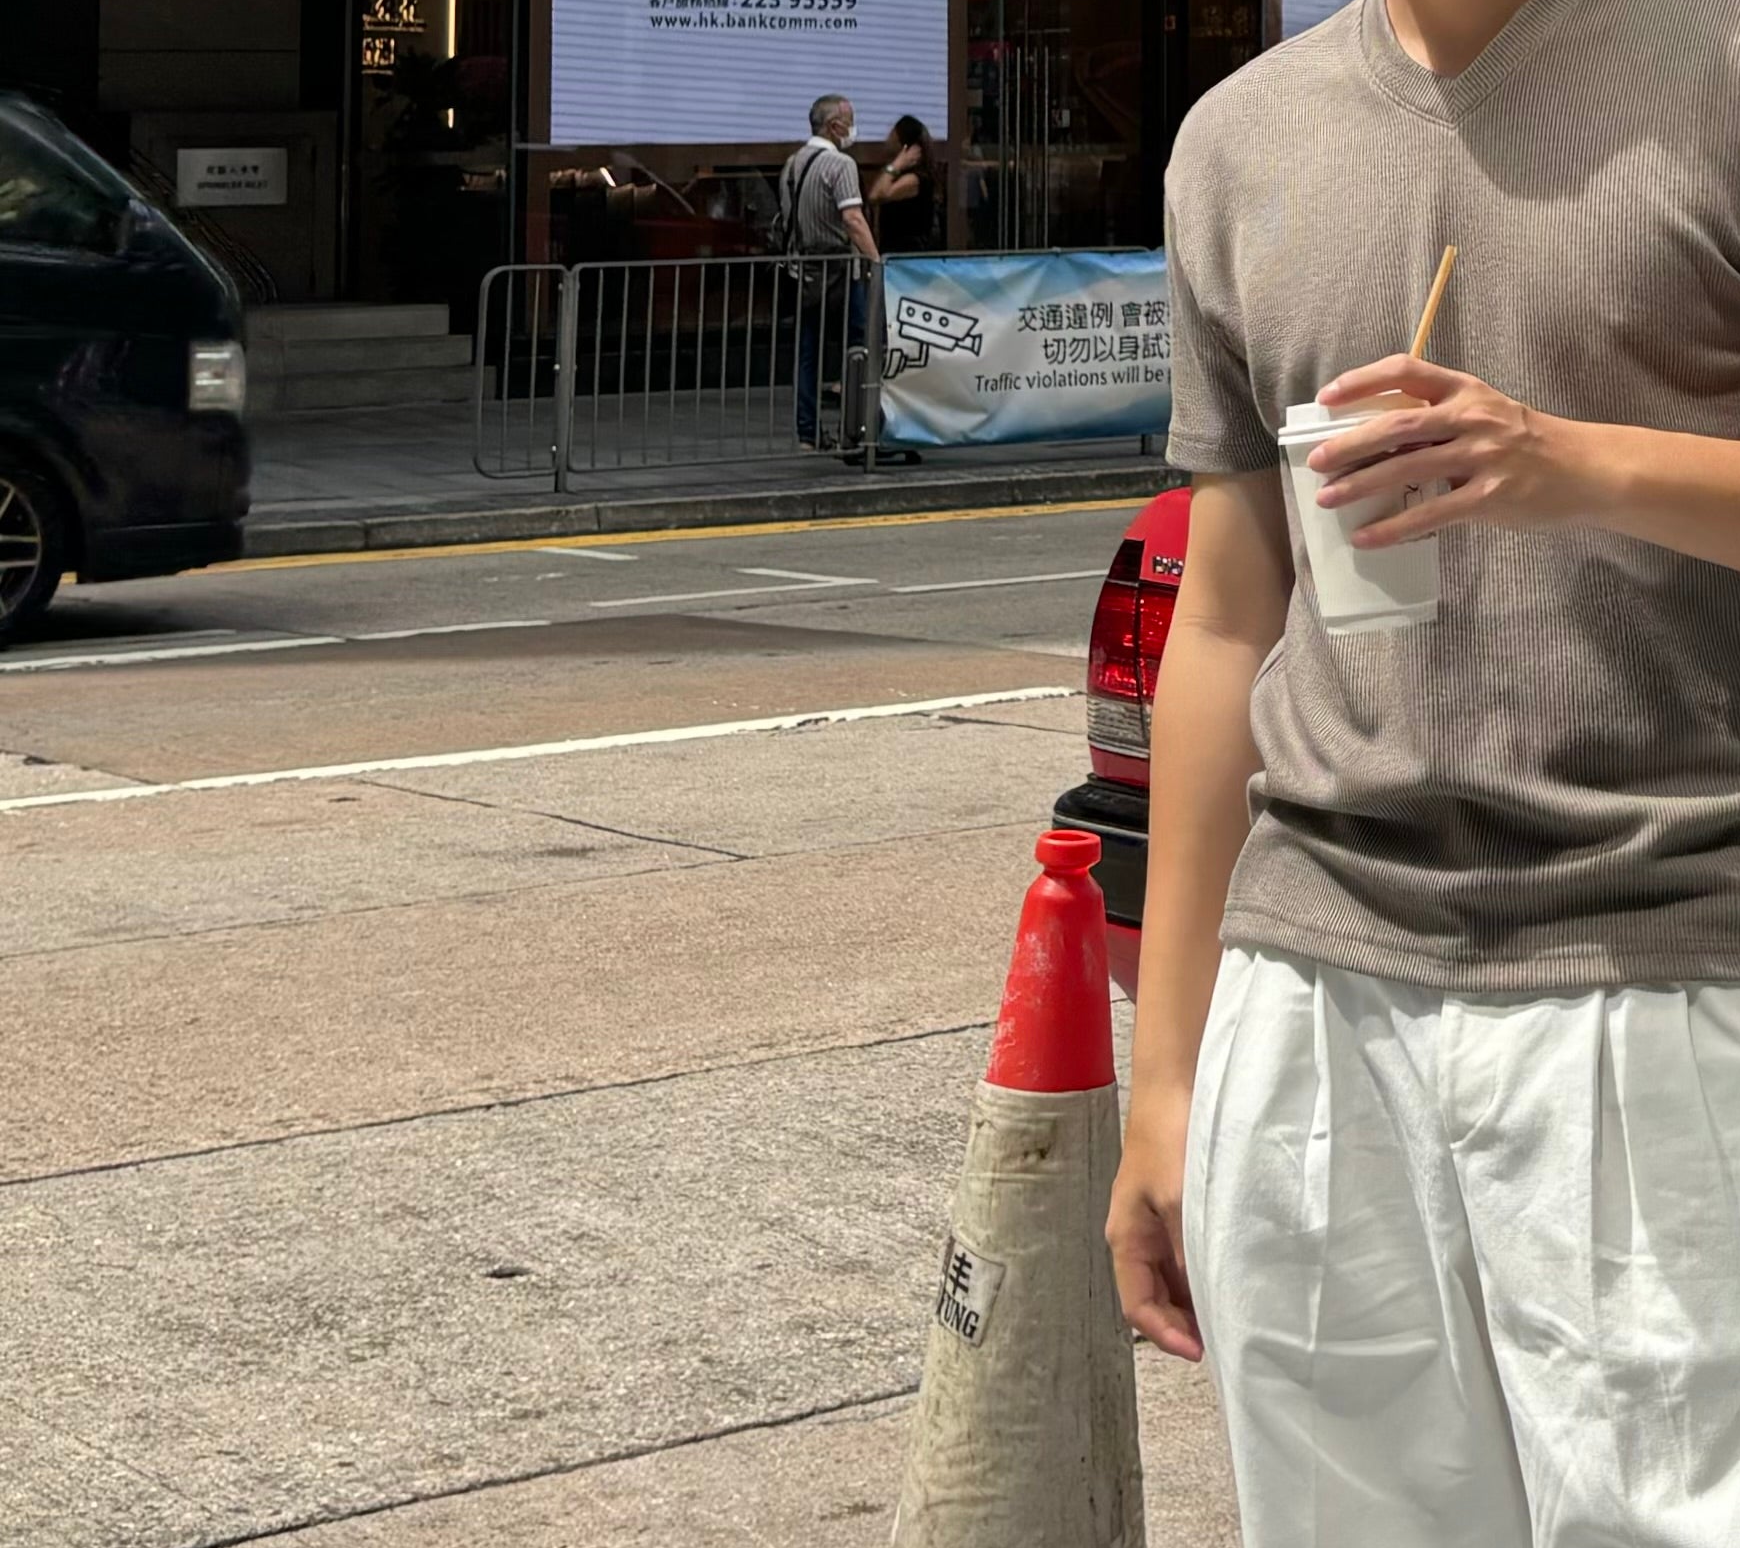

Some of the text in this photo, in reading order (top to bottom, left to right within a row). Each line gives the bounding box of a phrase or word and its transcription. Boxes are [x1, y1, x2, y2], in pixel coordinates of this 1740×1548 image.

[650, 12, 859, 29] www.hk.bankcomm.com
[1017, 299, 1170, 332] 交通違例 會被
[975, 365, 1164, 392] Traffic violations will be
